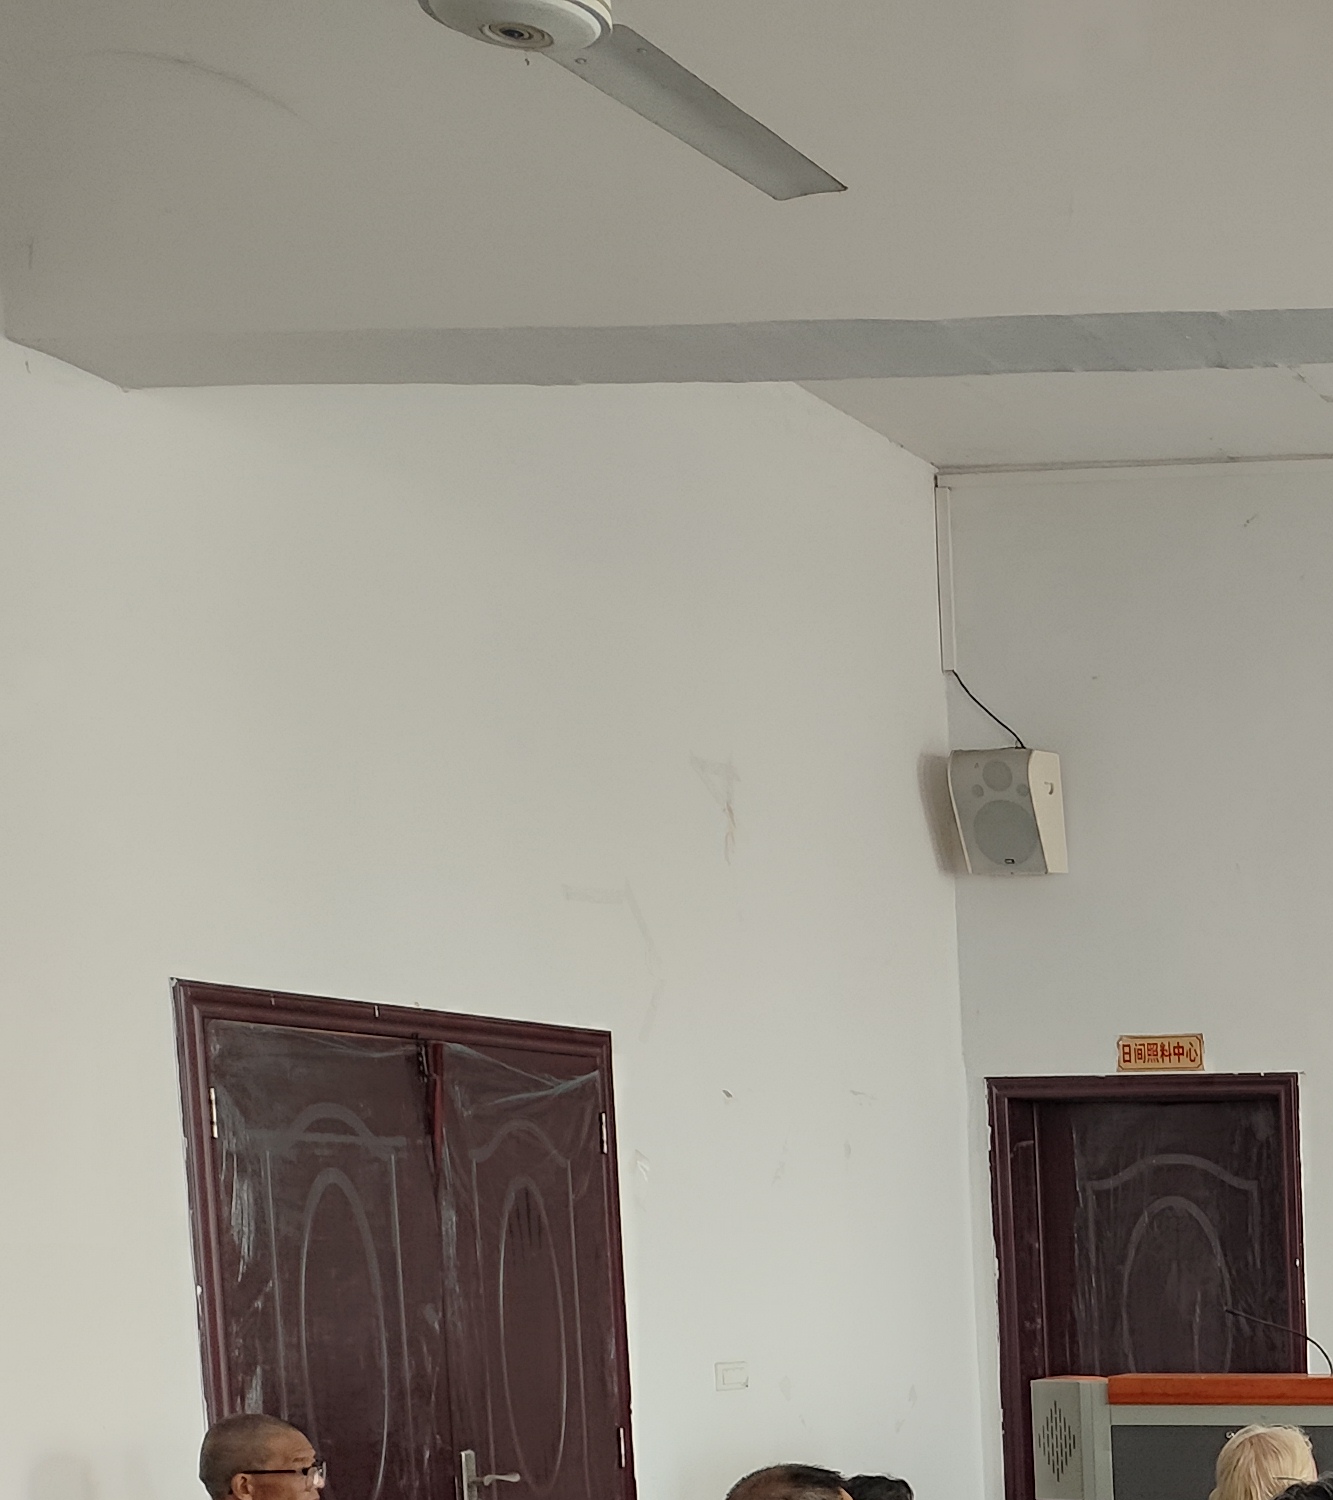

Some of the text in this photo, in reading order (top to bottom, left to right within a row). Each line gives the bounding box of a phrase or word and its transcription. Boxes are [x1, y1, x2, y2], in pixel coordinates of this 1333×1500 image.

[1122, 1041, 1199, 1064] 日间照料中心
